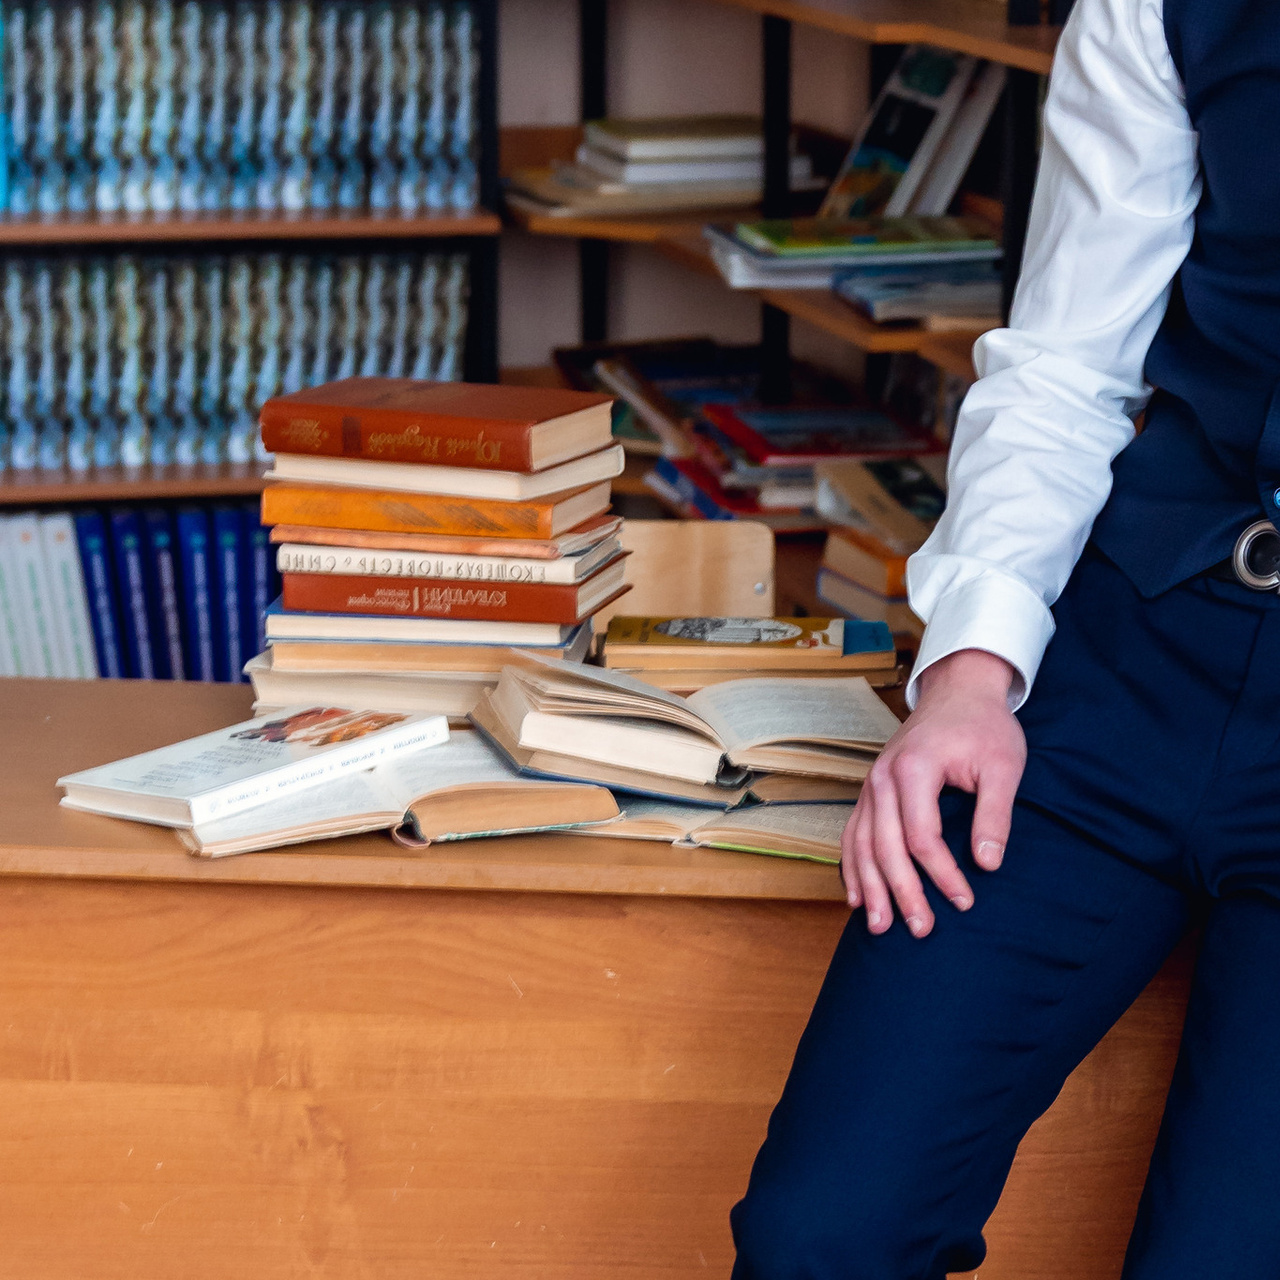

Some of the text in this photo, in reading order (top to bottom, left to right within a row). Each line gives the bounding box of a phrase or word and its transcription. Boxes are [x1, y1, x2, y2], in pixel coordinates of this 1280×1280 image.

[368, 424, 502, 463] Юрий Казаков
[280, 553, 336, 571] СЫНЕ
[424, 587, 507, 606] КУВАЛДИН
